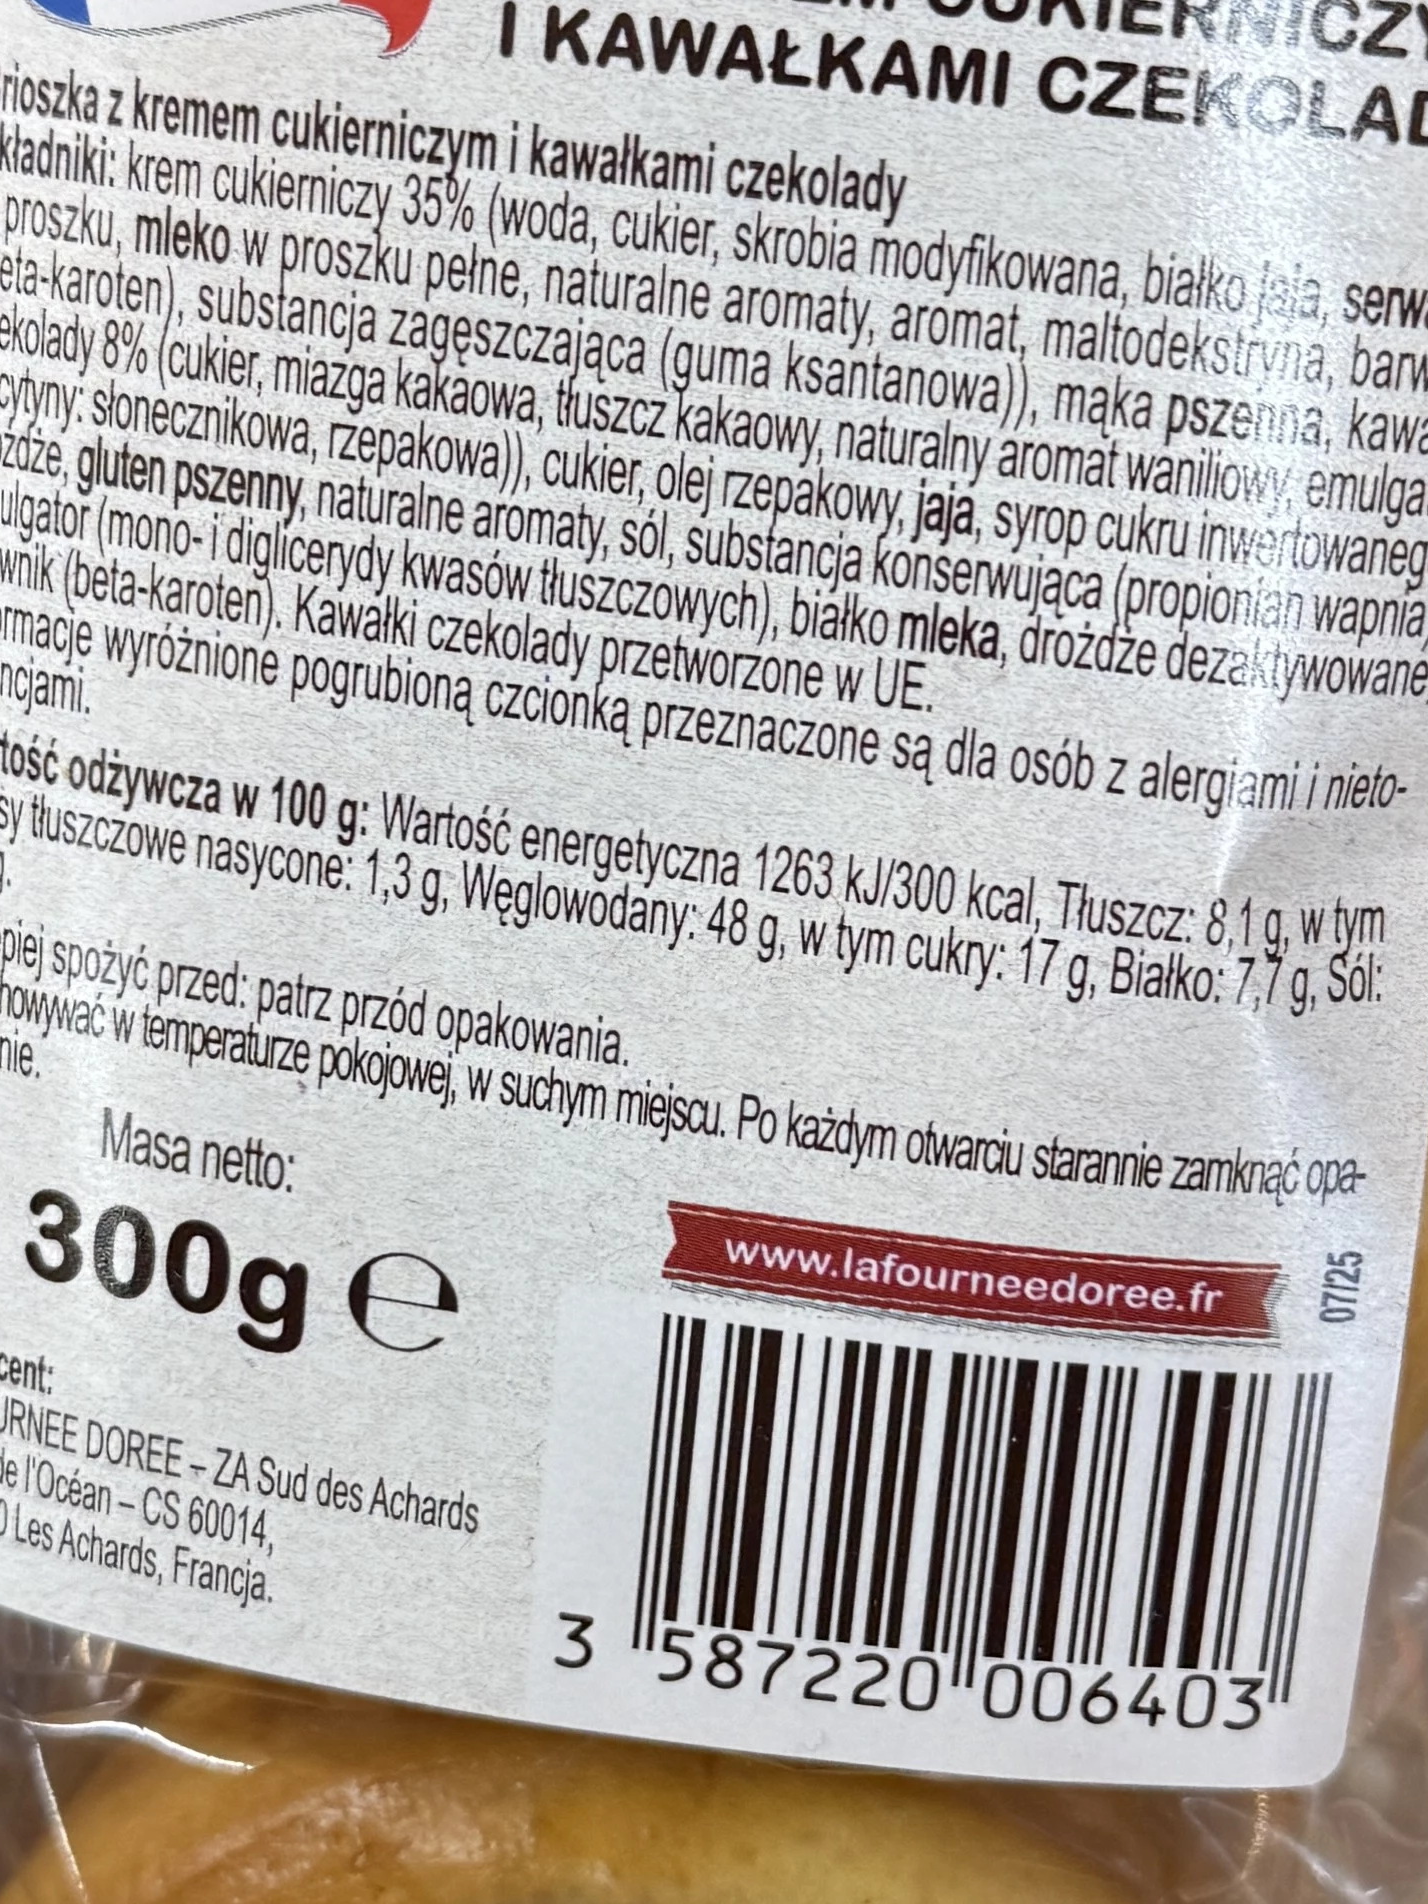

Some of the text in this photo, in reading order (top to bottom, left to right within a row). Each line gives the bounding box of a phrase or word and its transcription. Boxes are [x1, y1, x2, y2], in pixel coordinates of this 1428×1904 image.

[500, 0, 516, 58] I
[544, 5, 1011, 107] KAWAŁKAMI
[109, 91, 122, 122] z
[133, 78, 260, 144] kremem
[272, 99, 496, 174] cukierniczym
[509, 121, 518, 174] i
[531, 123, 716, 194] kawałkami
[726, 150, 907, 226] czekolady
[6, 194, 121, 256] proszku,
[135, 205, 231, 263] mleko
[244, 237, 266, 267] w
[280, 232, 411, 285] proszku
[426, 242, 529, 308] pełne,
[546, 258, 709, 319] naturalne
[724, 282, 876, 349] aromaty,
[891, 300, 1026, 362] aromat,
[129, 147, 201, 199] krem
[213, 156, 392, 233] cukierniczy
[402, 172, 473, 232] 35%
[488, 182, 598, 248] (woda,
[613, 200, 719, 266] cukier,
[733, 211, 856, 272] skrobia
[870, 228, 1128, 308] modyfikowana,
[1143, 249, 1246, 312] białko
[198, 283, 376, 355] substancja
[389, 308, 646, 384] zagęszczająca
[661, 327, 771, 392] (guma
[1054, 376, 1151, 438] mąka
[64, 547, 281, 641] (beta-karoten).
[295, 585, 417, 648] Kawałki
[427, 609, 591, 679] czekolady
[599, 635, 825, 693] przetworzone
[836, 673, 863, 701] w
[874, 656, 933, 712] UE.
[105, 613, 279, 685] wyróżnione
[291, 650, 473, 726] pogrubioną
[486, 673, 630, 748] czcionką
[643, 700, 880, 764] przeznaczone
[893, 730, 932, 785] są
[946, 726, 996, 779] dla
[1010, 737, 1094, 790] osób
[1107, 756, 1126, 794] z
[1139, 751, 1299, 818] alergiami
[1306, 762, 1319, 810] i
[1324, 762, 1407, 810] nieto-
[31, 794, 186, 864] tłuszczowe
[197, 835, 352, 891] nasycone:
[366, 848, 411, 904] 1,3
[421, 872, 448, 916] g,
[463, 860, 696, 950] Węglowodany:
[707, 897, 748, 946] 48
[758, 913, 786, 962] g,
[799, 918, 827, 956] w
[836, 917, 894, 974] tym
[906, 925, 1007, 991] cukry:
[1020, 937, 1060, 987] 17
[1110, 947, 1224, 1004] Białko:
[1328, 952, 1383, 1004] Sól:
[69, 748, 220, 815] odżywcza
[232, 786, 259, 820] w
[272, 776, 326, 831] 100
[338, 797, 369, 847] g:
[381, 790, 511, 857] Wartość
[521, 823, 739, 888] energetyczna
[756, 843, 834, 898] 1263
[845, 853, 956, 916] kJ/300
[967, 869, 1041, 933] kcal,
[1057, 879, 1195, 945] Tłuszcz:
[1206, 896, 1253, 956] 8,1
[1300, 905, 1326, 944] w
[1334, 897, 1386, 958] tym
[53, 939, 148, 991] spożyć
[158, 961, 246, 1013] przed:
[257, 973, 331, 1024] patrz
[341, 984, 427, 1041] przód
[435, 1000, 630, 1067] opakowania.
[102, 1106, 295, 1193] Masa netto:
[24, 1188, 308, 1354] 300g
[724, 1230, 1364, 1324] www.lafourneedoree.fr 07/25
[15, 1502, 54, 1551] Les
[60, 1518, 163, 1586] Achards,
[173, 1544, 272, 1604] Francja.
[86, 1424, 184, 1478] DOREE
[213, 1447, 249, 1492] ZA
[257, 1457, 309, 1503] Sud
[316, 1468, 363, 1514] des
[370, 1477, 479, 1534] Achards
[143, 1485, 180, 1531] CS
[188, 1495, 274, 1556] 60014,
[552, 1612, 1263, 1731] 3 587220 006403
